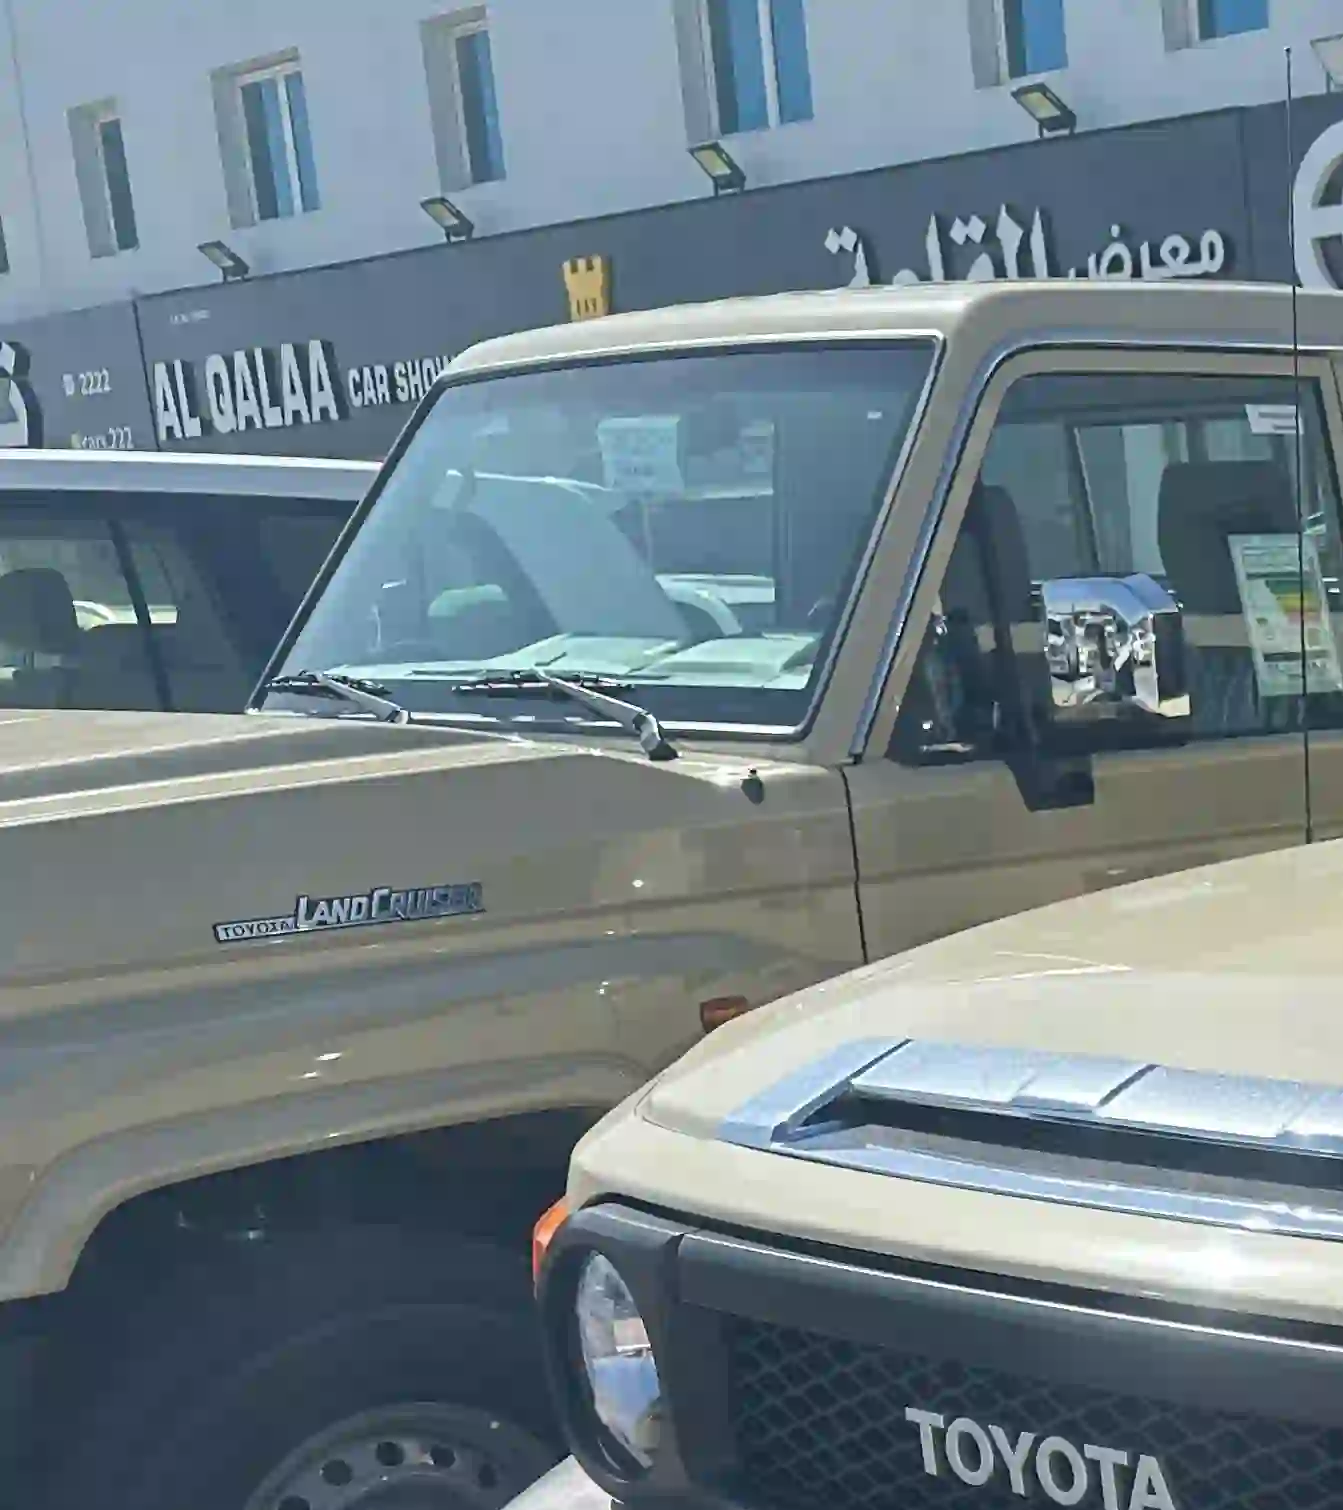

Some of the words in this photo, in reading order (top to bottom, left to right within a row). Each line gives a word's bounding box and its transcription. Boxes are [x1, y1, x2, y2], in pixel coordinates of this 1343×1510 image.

[154, 359, 202, 441] AL
[205, 339, 339, 434] QALAA
[348, 364, 391, 407] CAR
